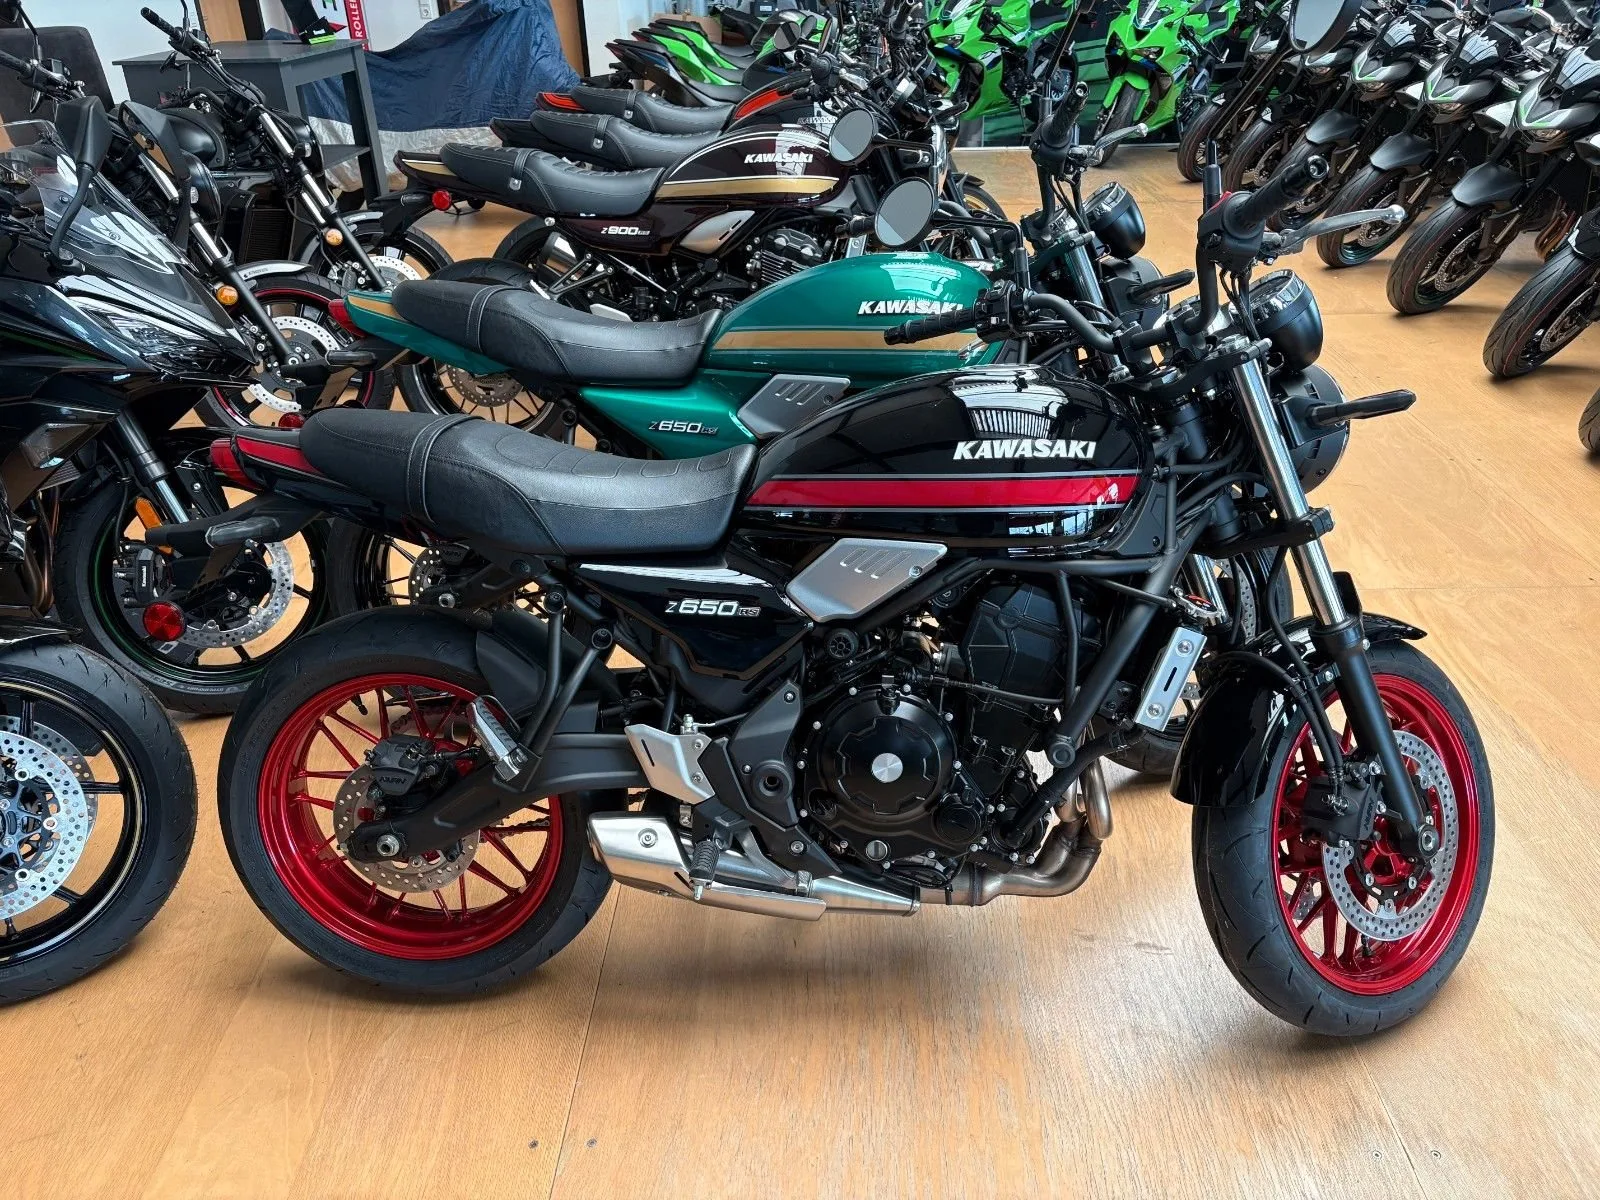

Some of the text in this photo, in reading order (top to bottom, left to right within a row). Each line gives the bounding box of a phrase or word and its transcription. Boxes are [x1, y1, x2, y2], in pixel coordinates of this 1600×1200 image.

[349, 0, 363, 38] ROLLE
[744, 152, 814, 163] KAWASAKI
[952, 438, 1097, 460] KAWASAKI
